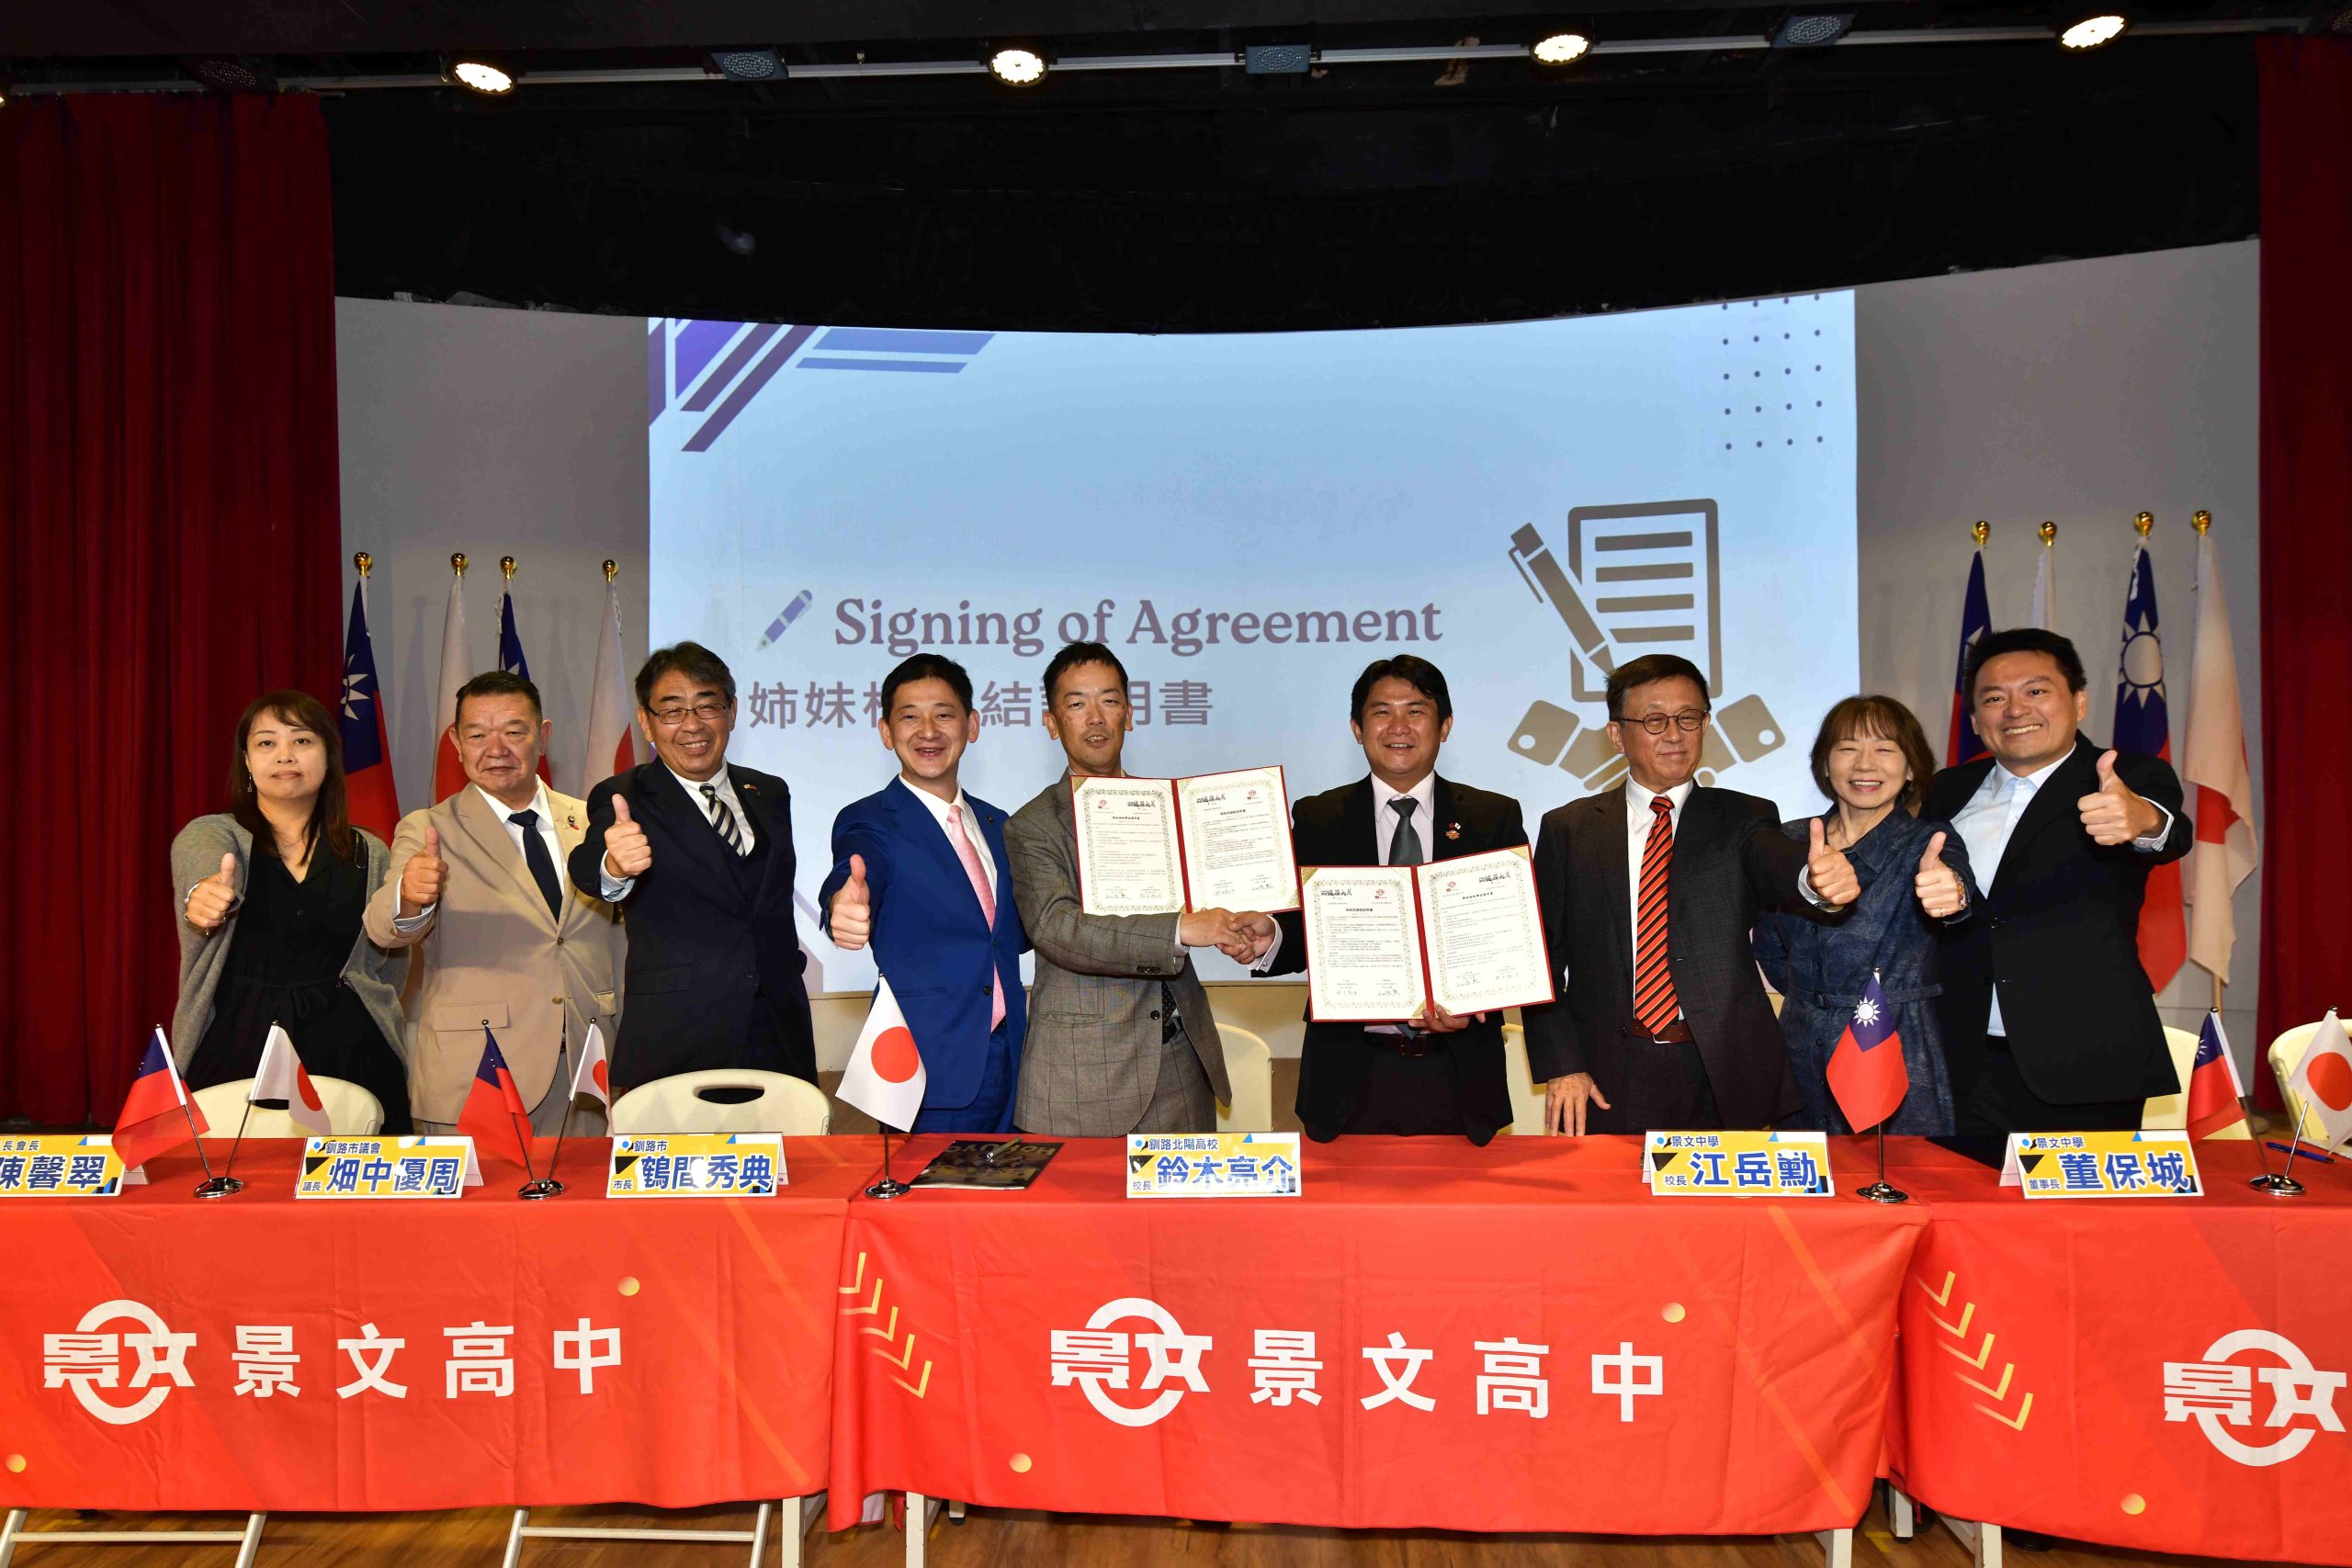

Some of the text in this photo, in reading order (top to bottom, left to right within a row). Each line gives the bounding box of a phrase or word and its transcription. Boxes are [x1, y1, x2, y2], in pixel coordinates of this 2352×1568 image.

[835, 598, 1443, 658] Signing of Agreement
[634, 1140, 668, 1152] 釧路市
[1148, 1138, 1218, 1151] 釧路北陽高校
[1671, 1135, 1719, 1147] 景文中學
[2036, 1137, 2084, 1149] 景文中學
[325, 1142, 381, 1155] 釧路市議會
[301, 1157, 459, 1192] 議長 畑中優周
[2028, 1152, 2189, 1190] 董事長 董保城
[613, 1179, 632, 1190] 市長
[1132, 1180, 1151, 1190] 校長
[1664, 1176, 1687, 1186] 校長
[231, 1317, 621, 1399] 景文高中
[1248, 1328, 1663, 1423] 景文高中
